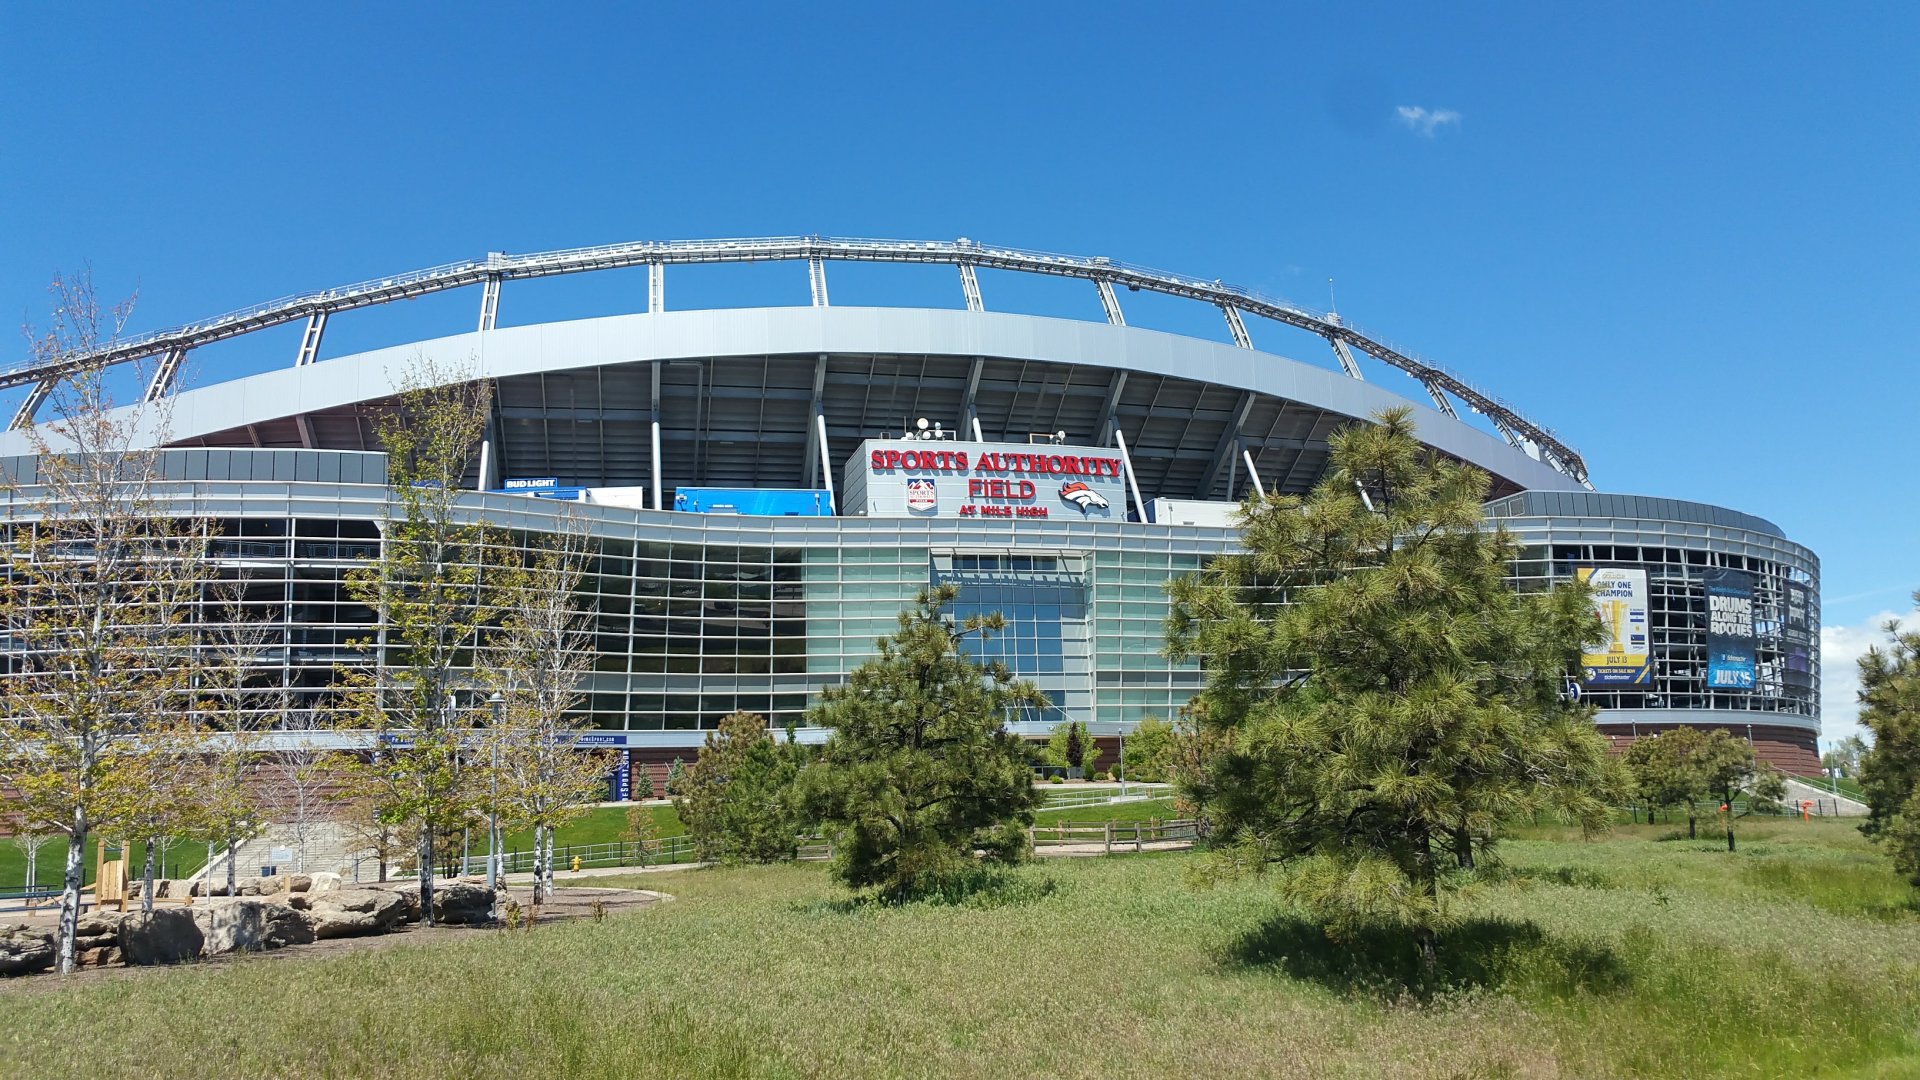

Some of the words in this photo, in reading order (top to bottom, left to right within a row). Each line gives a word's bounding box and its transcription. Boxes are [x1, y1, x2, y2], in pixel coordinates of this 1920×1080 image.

[871, 450, 969, 471] SPORTS
[976, 452, 1122, 477] AUTHORITY
[527, 479, 555, 487] LIGHT
[968, 479, 1036, 499] FIELD
[959, 505, 976, 516] AT
[980, 505, 1012, 516] MILE
[1016, 506, 1048, 518] HIGH
[1597, 581, 1615, 589] ONLY
[1617, 581, 1632, 589] ONE
[1709, 595, 1752, 614] DRUMS
[1711, 611, 1737, 623] ALONG
[1738, 613, 1752, 624] THE
[1710, 621, 1752, 637] ROCKIES
[1606, 656, 1620, 664] JULY
[1714, 669, 1739, 684] JULY
